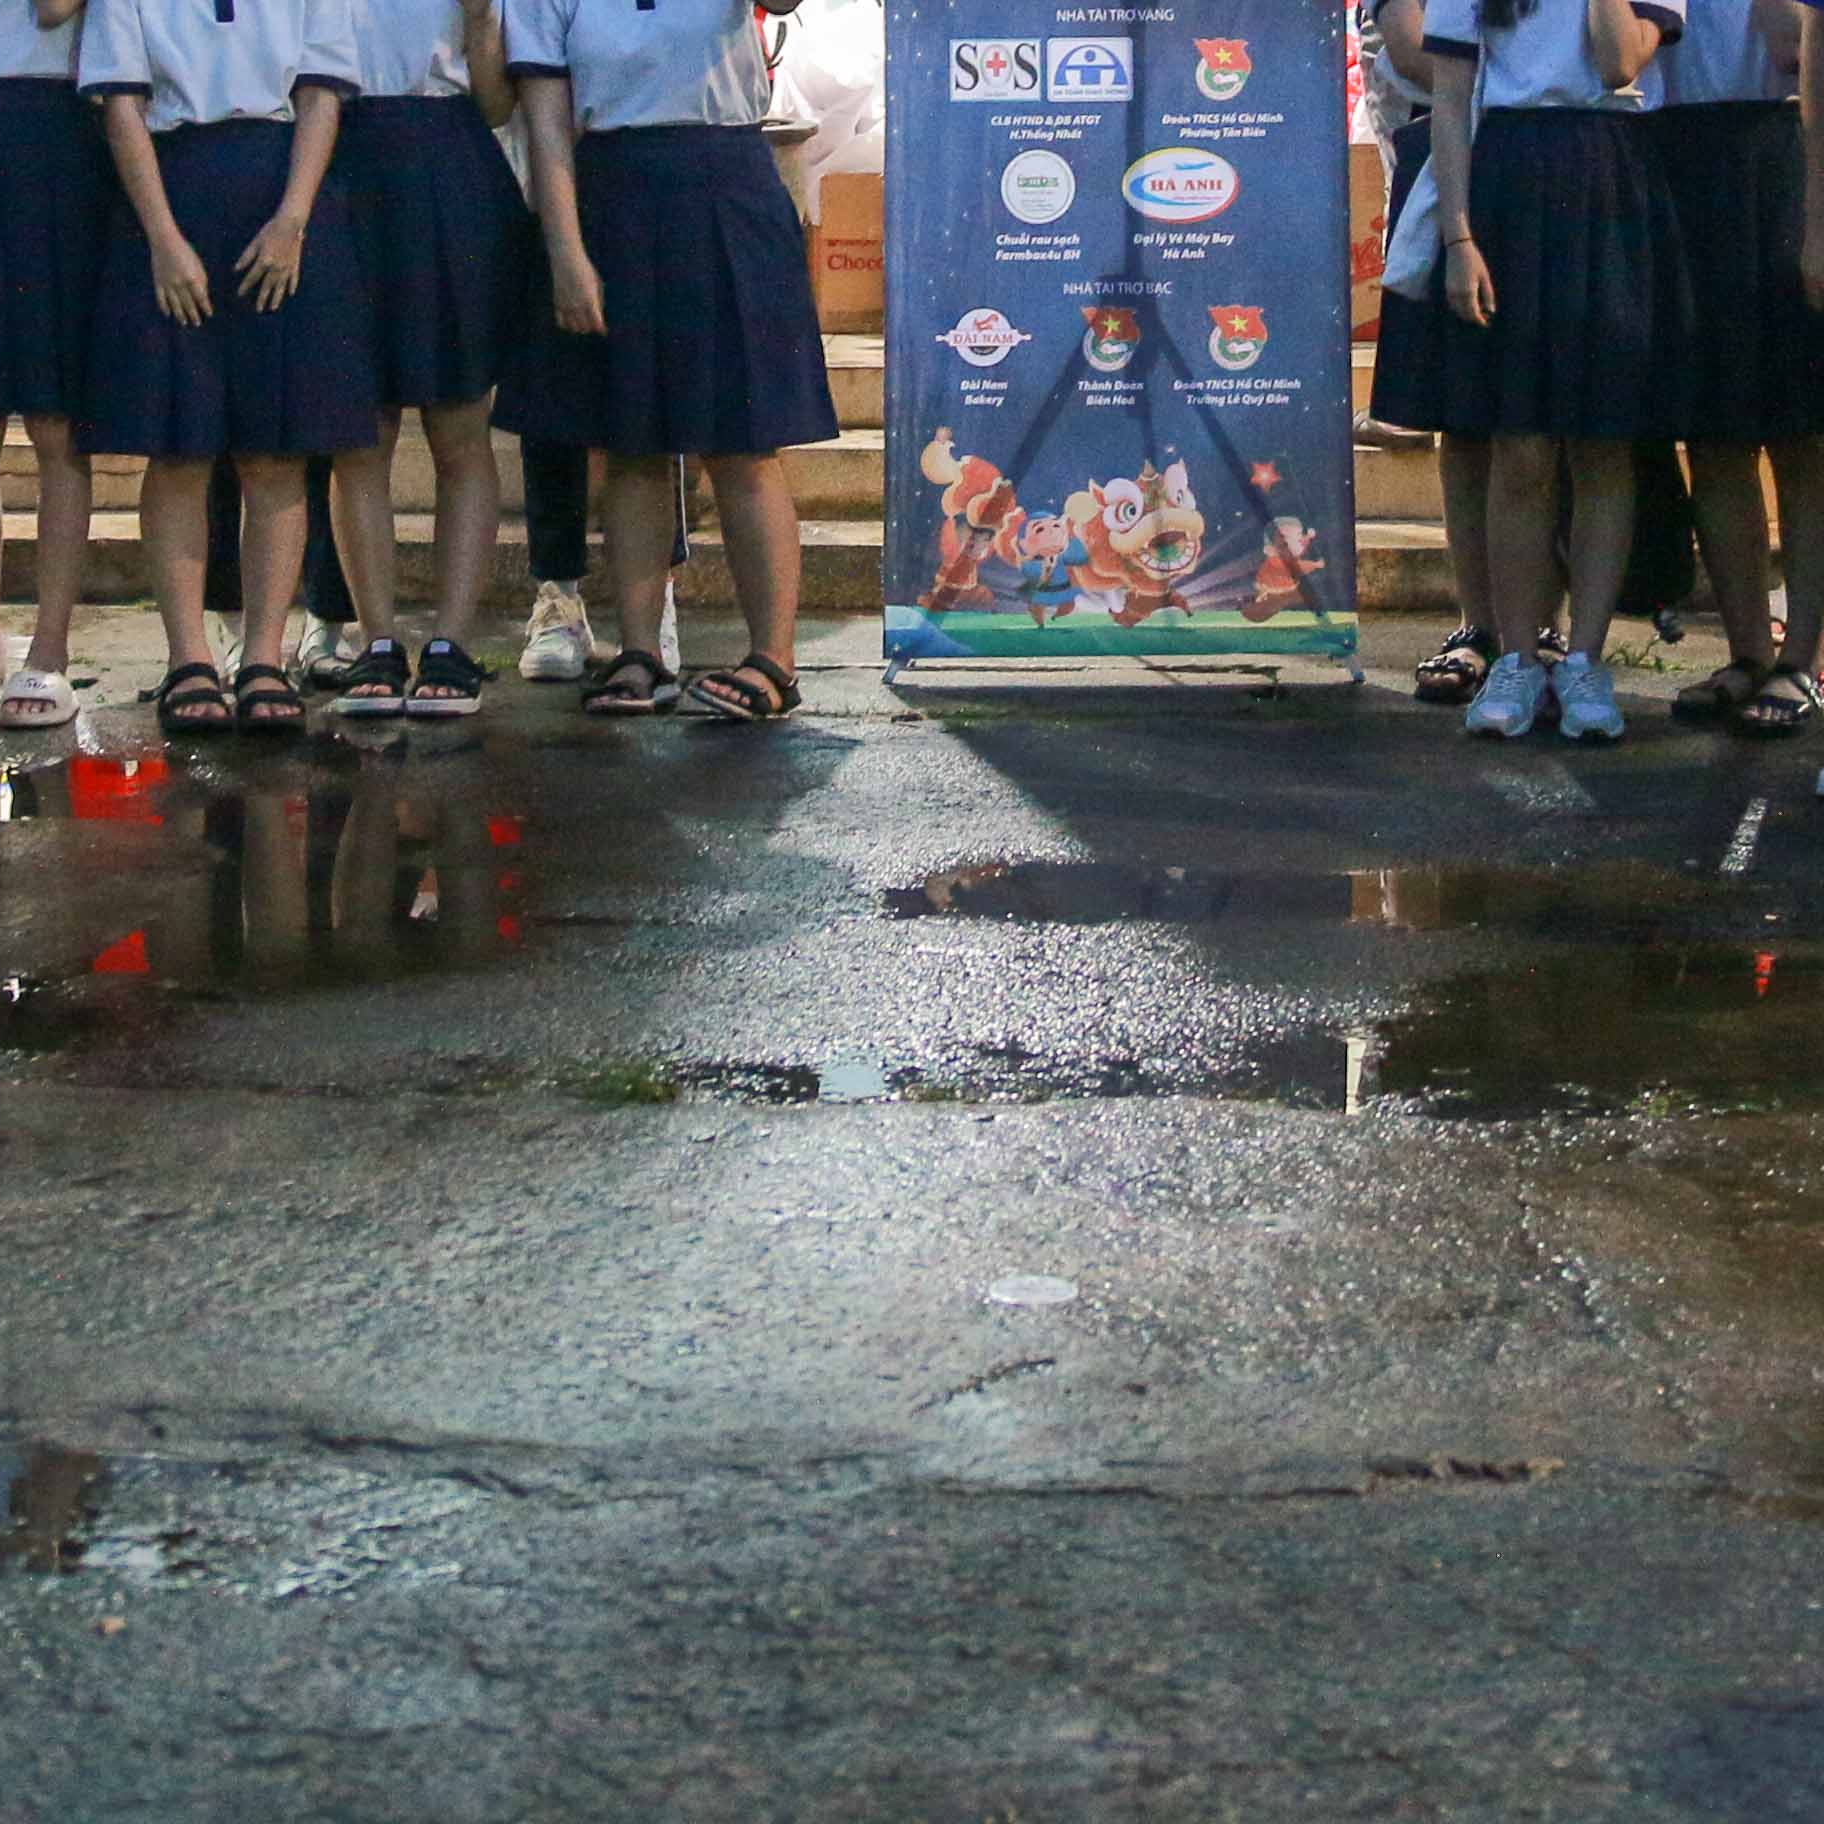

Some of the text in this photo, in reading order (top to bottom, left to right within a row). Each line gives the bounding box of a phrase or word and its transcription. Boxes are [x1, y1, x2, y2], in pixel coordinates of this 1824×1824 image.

[1056, 9, 1087, 22] NHÀ
[1089, 9, 1107, 22] TÀI
[1137, 8, 1175, 22] VÀNG
[991, 115, 1012, 126] CLB
[1257, 113, 1284, 123] Minh
[1151, 178, 1222, 191] HÀ ANH
[1031, 236, 1052, 245] rau
[1052, 233, 1081, 247] sạch
[1185, 233, 1211, 245] Máy
[1211, 233, 1234, 246] Bay
[1062, 248, 1081, 261] BH
[1181, 247, 1206, 259] Anh
[1146, 280, 1173, 296] BẠC
[983, 333, 1014, 344] NAM
[982, 379, 1008, 390] Nam
[1205, 379, 1234, 390] TNCS
[1273, 378, 1301, 389] Minh
[964, 395, 1005, 408] Bakery
